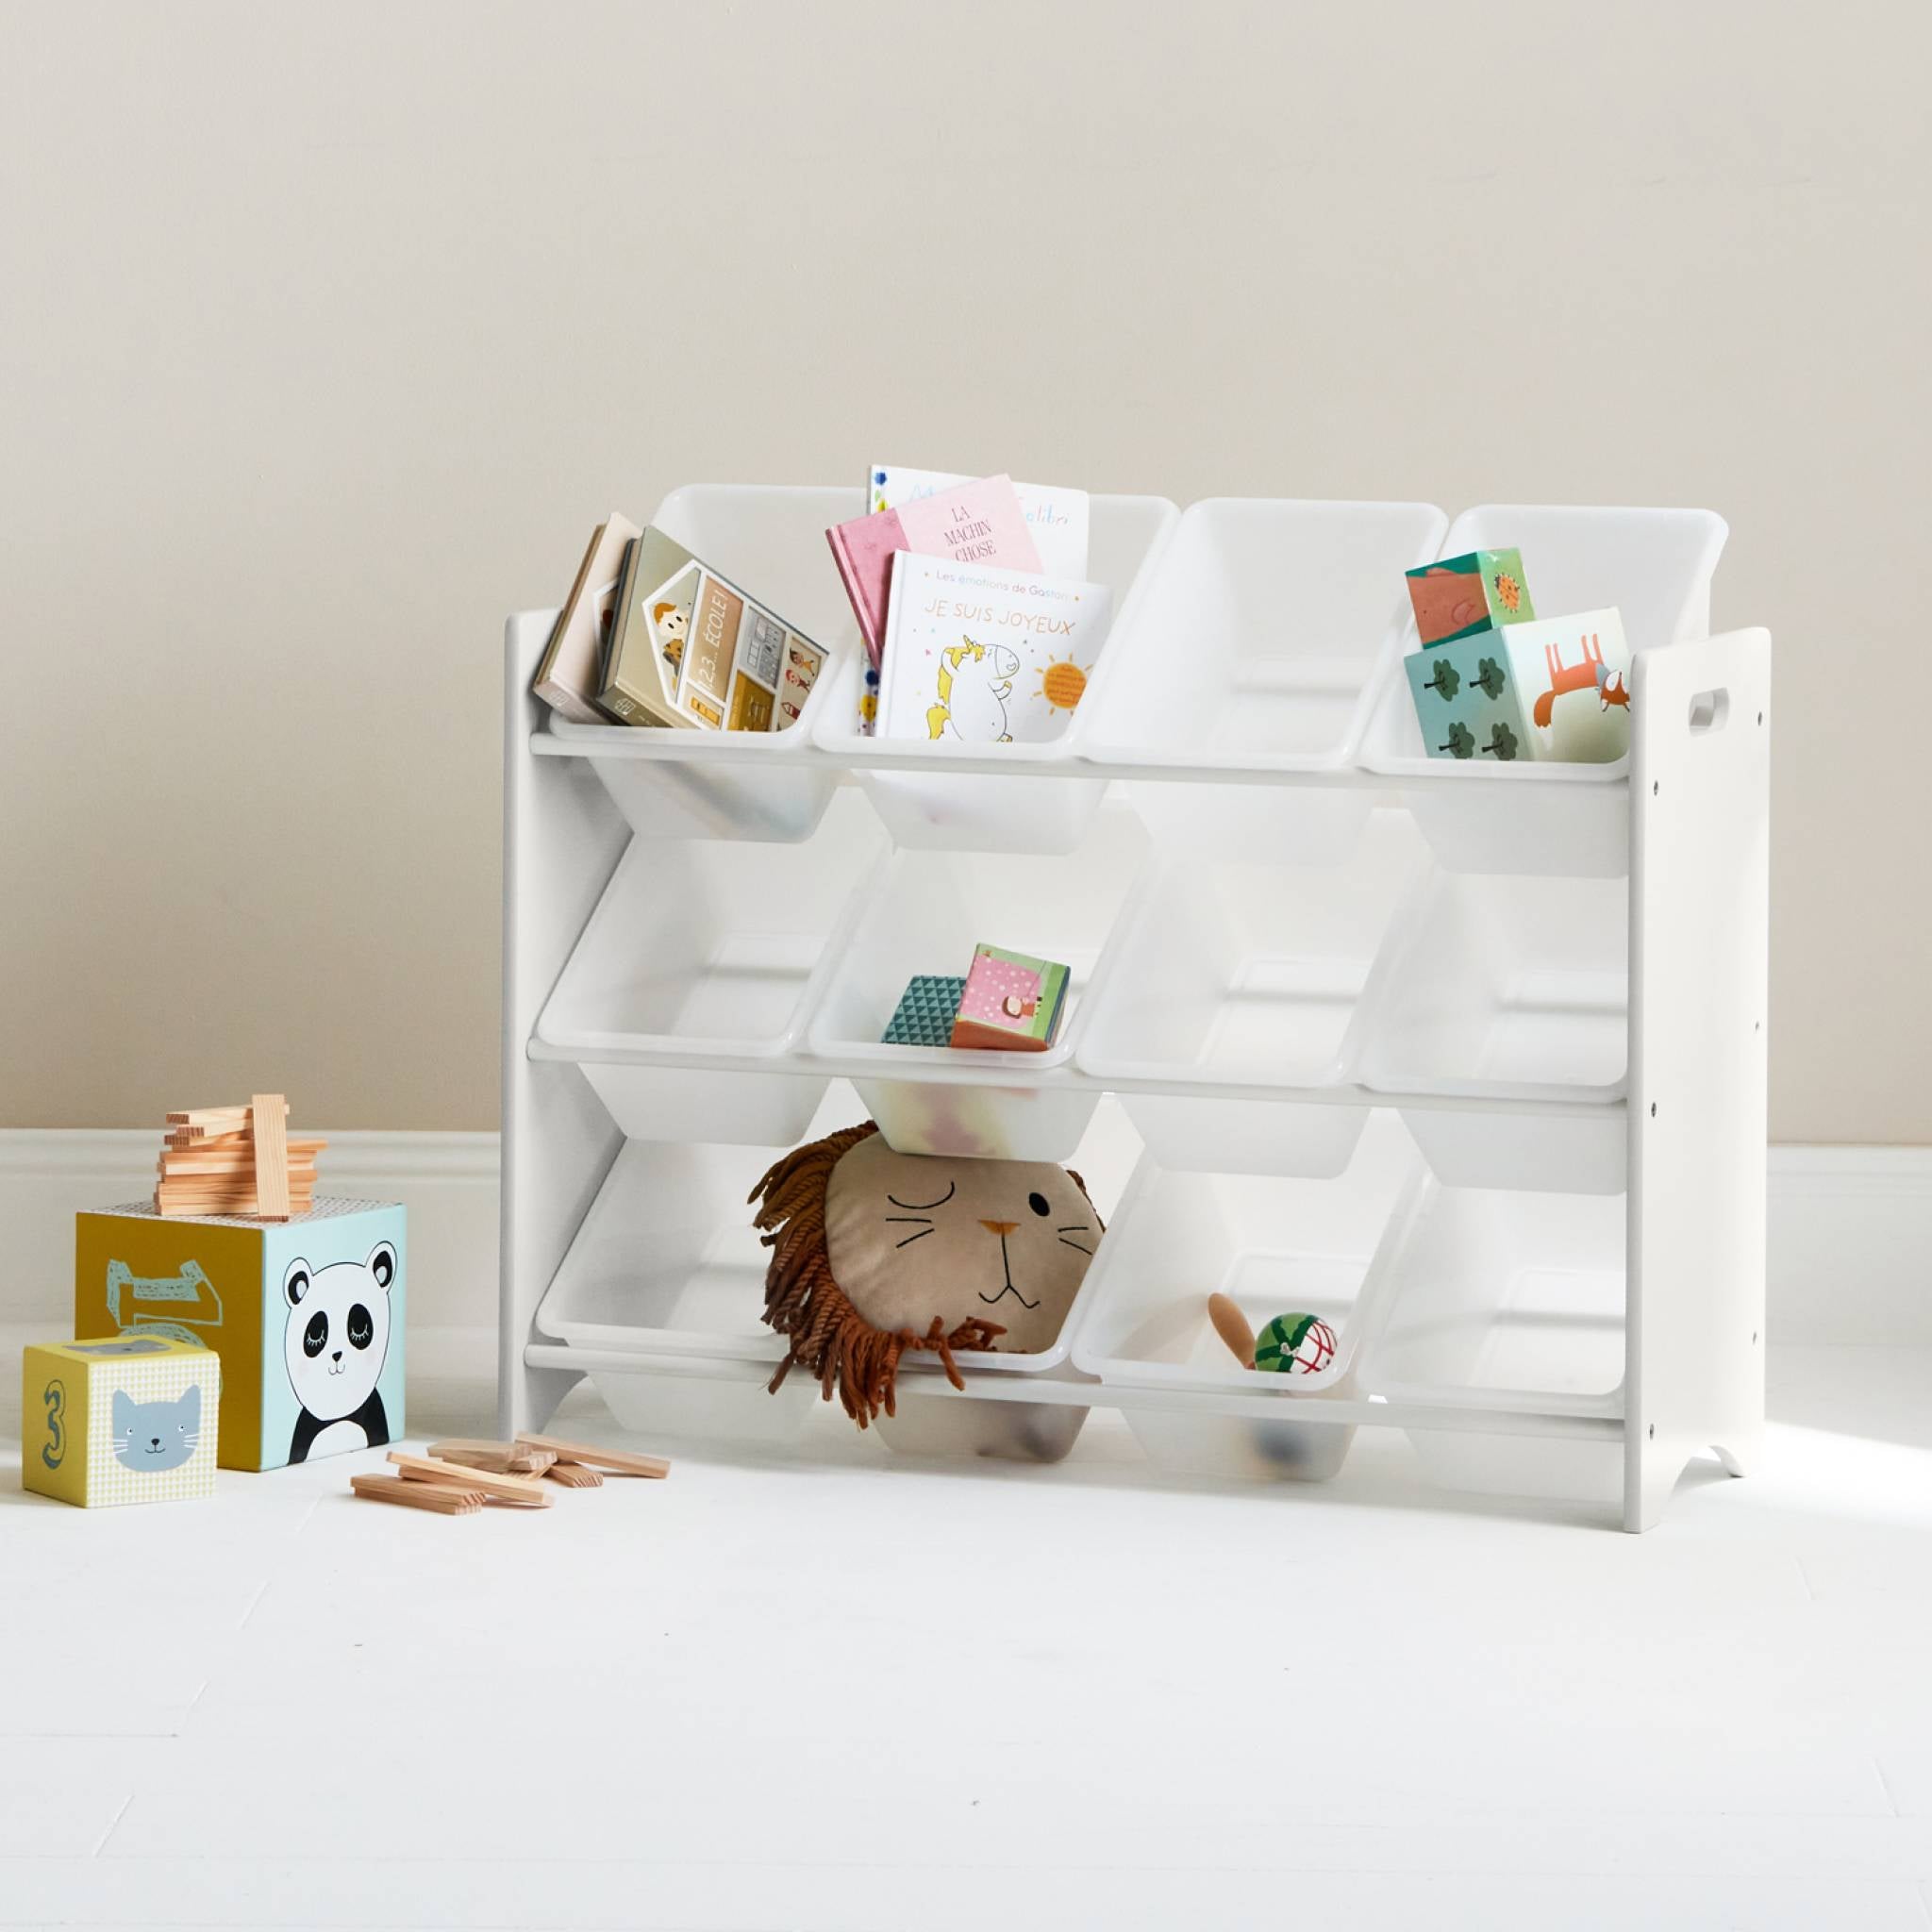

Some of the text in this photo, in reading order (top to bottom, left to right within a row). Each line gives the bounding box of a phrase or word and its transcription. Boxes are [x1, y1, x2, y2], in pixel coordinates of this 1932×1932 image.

[951, 506, 972, 523] LA
[943, 519, 993, 547] MACHIN
[955, 540, 997, 563] CHOSE
[936, 570, 1070, 601] Les émotions de Gaston
[924, 598, 1076, 636] JE SUIS JOYEUX
[42, 1379, 66, 1470] 3
